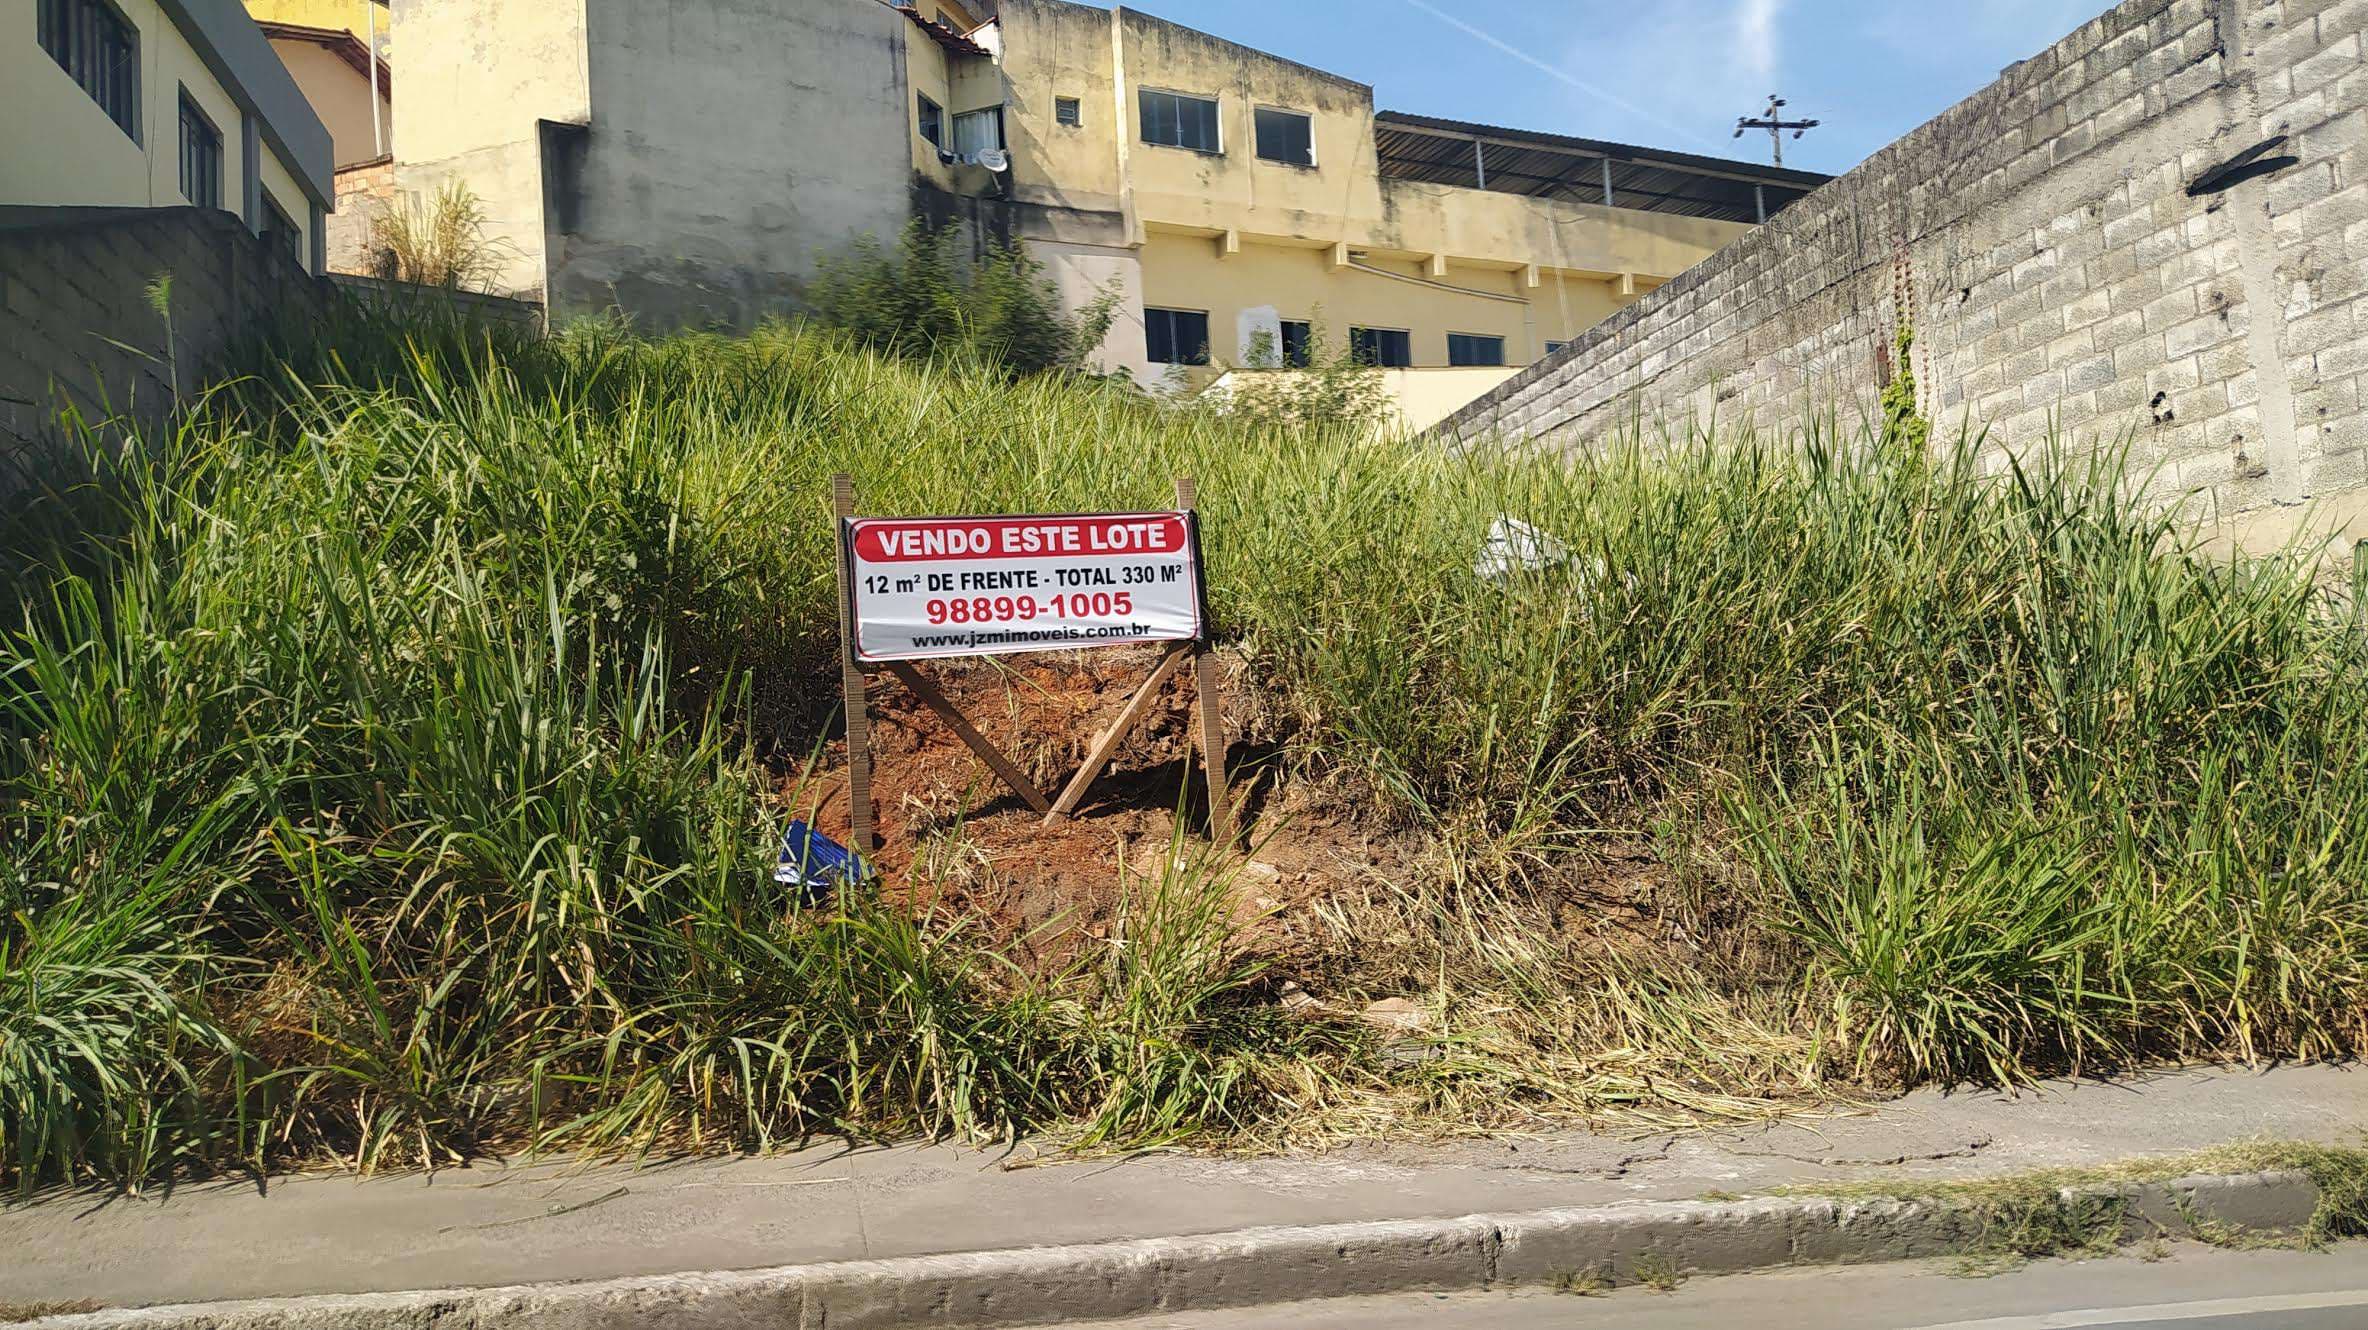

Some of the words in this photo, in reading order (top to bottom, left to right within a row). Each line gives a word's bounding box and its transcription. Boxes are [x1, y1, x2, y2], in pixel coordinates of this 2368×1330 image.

[878, 528, 991, 556] VENDO
[1002, 526, 1081, 552] ESTE
[1091, 524, 1166, 550] LOTE
[865, 576, 888, 593] 12
[928, 573, 953, 592] DE
[961, 571, 1038, 590] FRENTE
[1055, 568, 1116, 586] TOTAL
[1122, 566, 1154, 584] 330
[926, 592, 1133, 624] 98899-1005
[913, 623, 1151, 648] www.jzmimoveis.com.br
